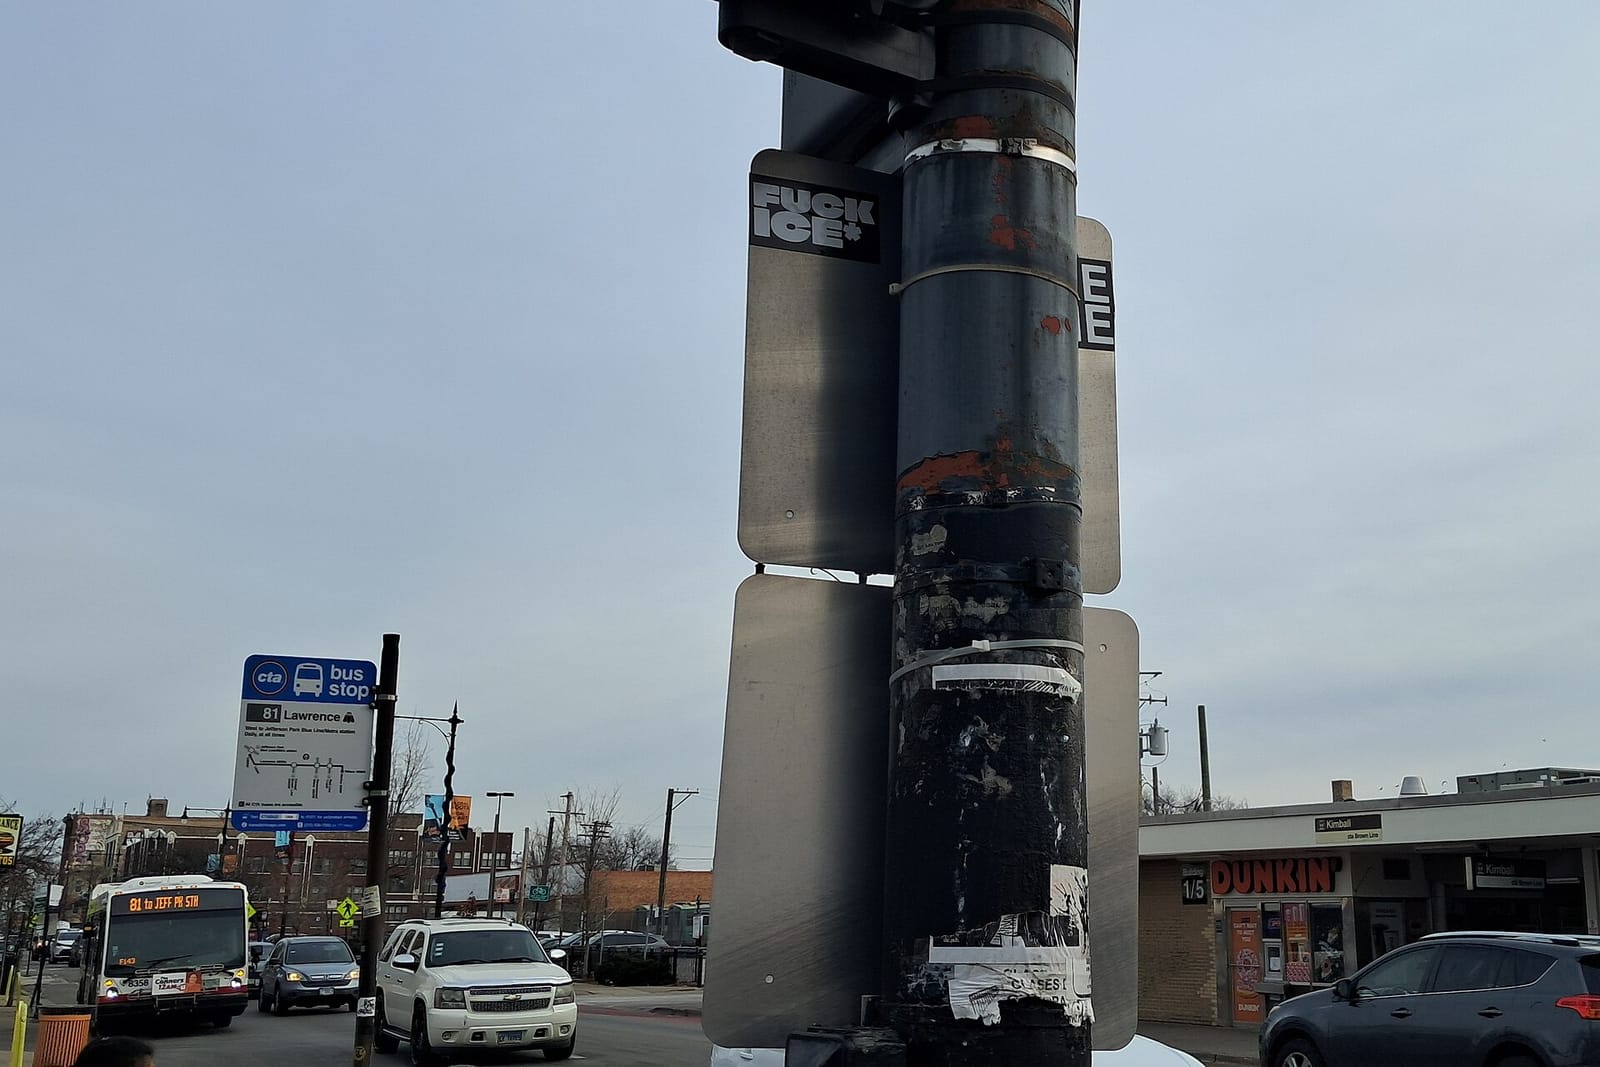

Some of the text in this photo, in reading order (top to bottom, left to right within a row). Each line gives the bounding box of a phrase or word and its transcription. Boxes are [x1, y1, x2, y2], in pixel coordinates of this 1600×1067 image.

[752, 181, 875, 225] FUCK
[257, 671, 282, 683] cta
[330, 664, 364, 681] bus
[328, 681, 369, 701] stop
[262, 707, 341, 722] 81 Lawrence
[1326, 818, 1352, 829] Kimball
[1485, 864, 1516, 875] Kimball
[1183, 879, 1204, 899] 1/5
[130, 897, 142, 912] 81
[144, 898, 153, 910] to
[154, 896, 173, 909] JEFF
[128, 979, 149, 988] 8358
